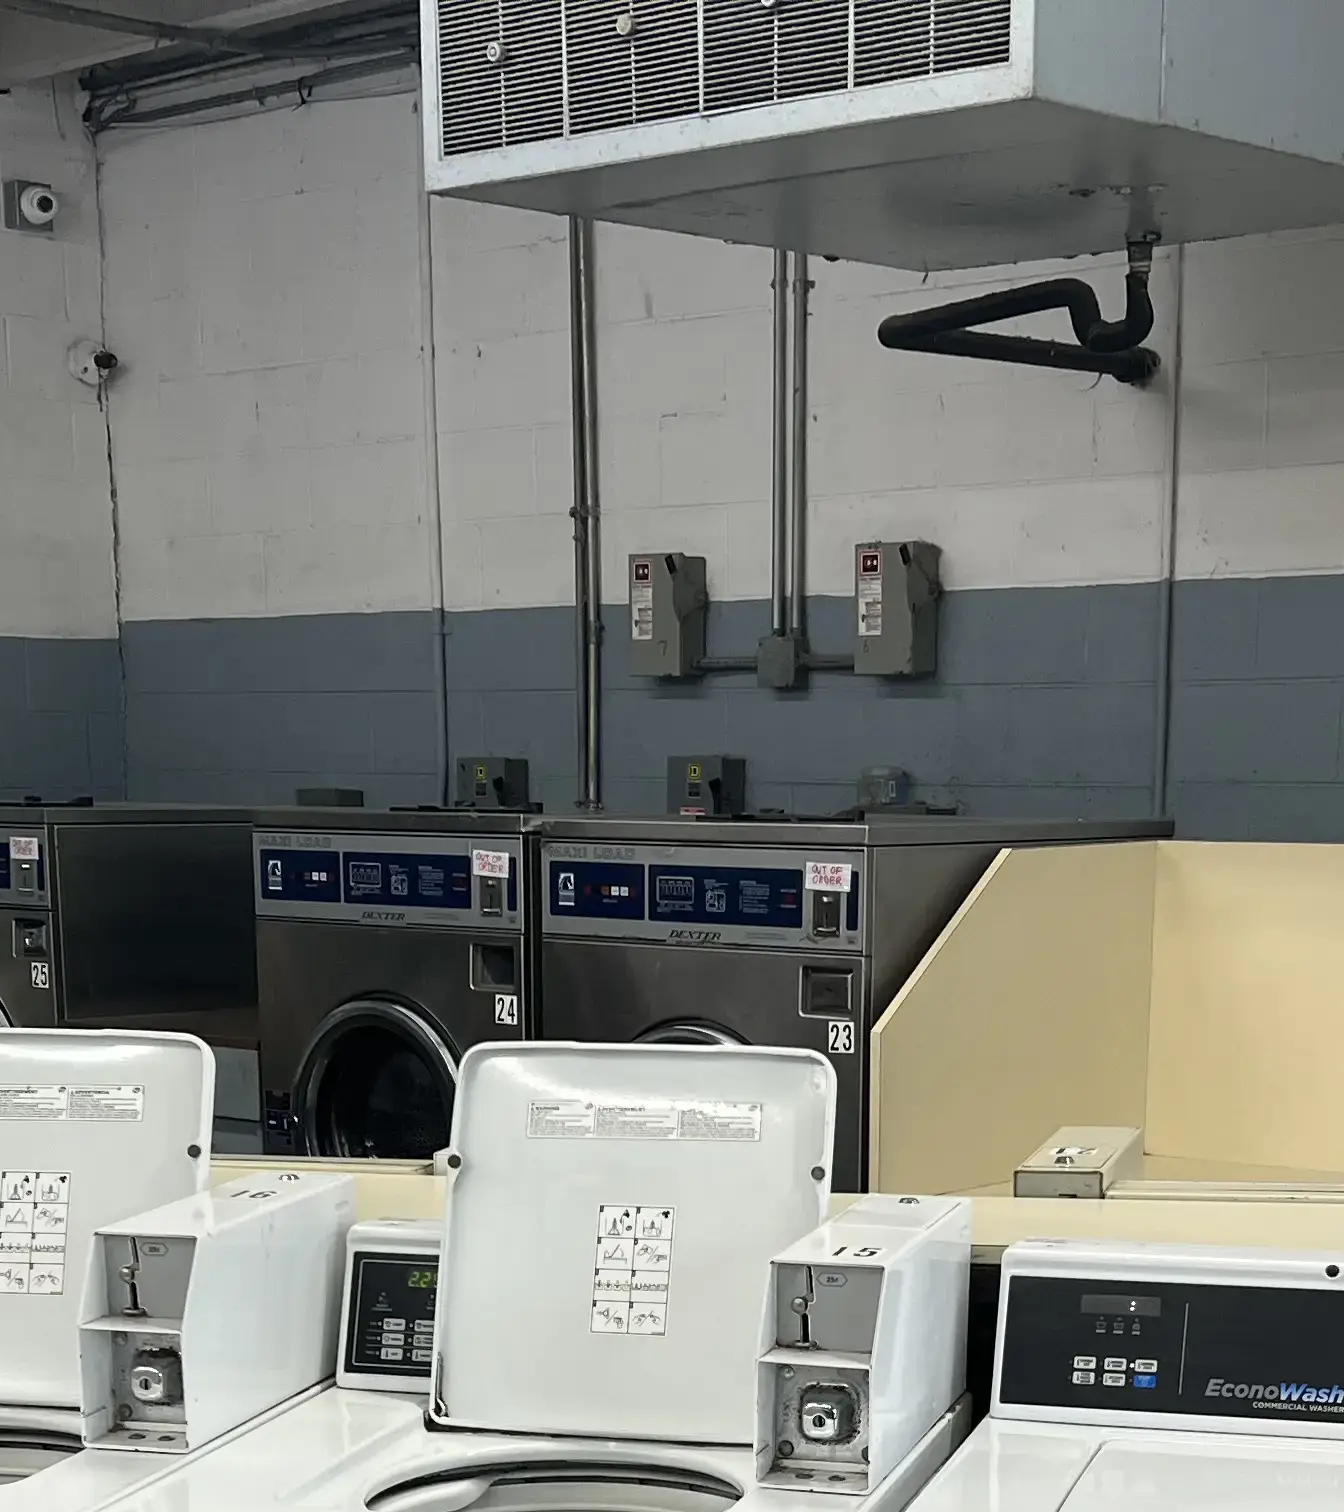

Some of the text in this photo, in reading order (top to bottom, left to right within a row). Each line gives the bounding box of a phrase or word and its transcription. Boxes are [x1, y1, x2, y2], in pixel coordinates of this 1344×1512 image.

[812, 863, 843, 876] OUT OF
[812, 874, 842, 886] ORDER
[361, 911, 406, 922] DEXTER
[669, 928, 722, 942] DEXTER
[32, 964, 48, 987] 25
[496, 997, 516, 1023] 24
[830, 1024, 852, 1051] 23
[230, 1190, 277, 1199] 16
[832, 1246, 883, 1257] 15
[1205, 1379, 1344, 1405] EconoWash
[1252, 1401, 1344, 1413] COMMERCIAL WASHER
